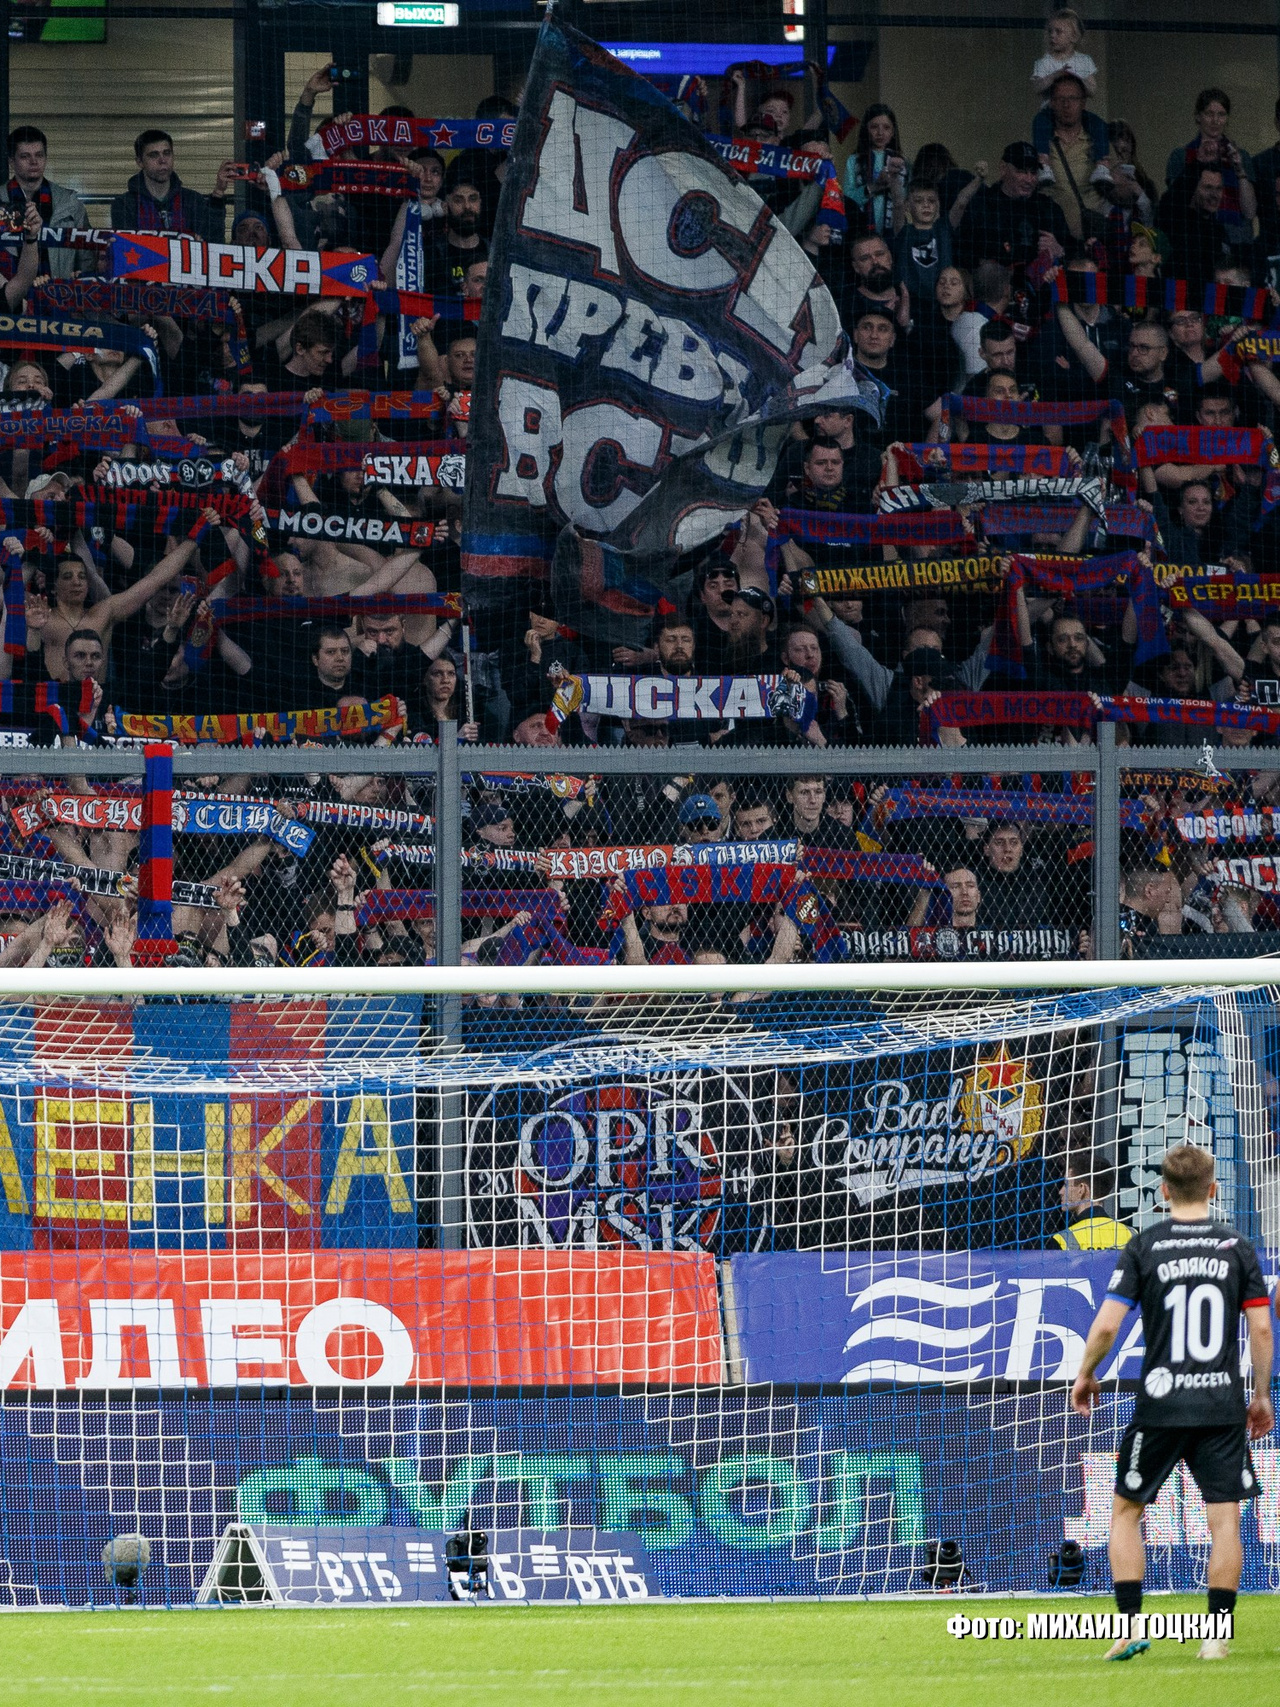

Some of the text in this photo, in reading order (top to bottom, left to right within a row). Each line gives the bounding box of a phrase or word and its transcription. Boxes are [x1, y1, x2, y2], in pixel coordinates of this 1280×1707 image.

[395, 4, 445, 24] ВЫХОД
[326, 119, 412, 151] ЦСКА
[753, 149, 776, 169] ЗА
[168, 239, 322, 295] ЦСКА
[43, 415, 123, 436] ЦСКА
[1144, 430, 1252, 456] ПФК ЦСКА
[277, 507, 404, 544] МОСКВА
[819, 561, 910, 593] НИЖНИЙ
[1173, 583, 1190, 602] В
[587, 675, 765, 719] ЦСКА
[1134, 696, 1165, 706] ОДНА
[1167, 697, 1214, 708] ЛЮБОВЬ
[122, 697, 393, 744] CSKA ULTRAS
[307, 800, 434, 836] ПЕТЕРБУРГА
[1176, 813, 1263, 840] MOSCOW
[634, 868, 782, 898] CSKA
[864, 1077, 964, 1134] Bad
[519, 1098, 716, 1188] OPR
[811, 1117, 1006, 1190] Company
[477, 1165, 757, 1197] 20 19
[1157, 1257, 1231, 1284] ОБЛЯКОВ
[1163, 1283, 1225, 1365] 10
[237, 1451, 925, 1553] ФУТБОЛ
[317, 1551, 404, 1598] ВТБ
[565, 1555, 650, 1599] ВТБ
